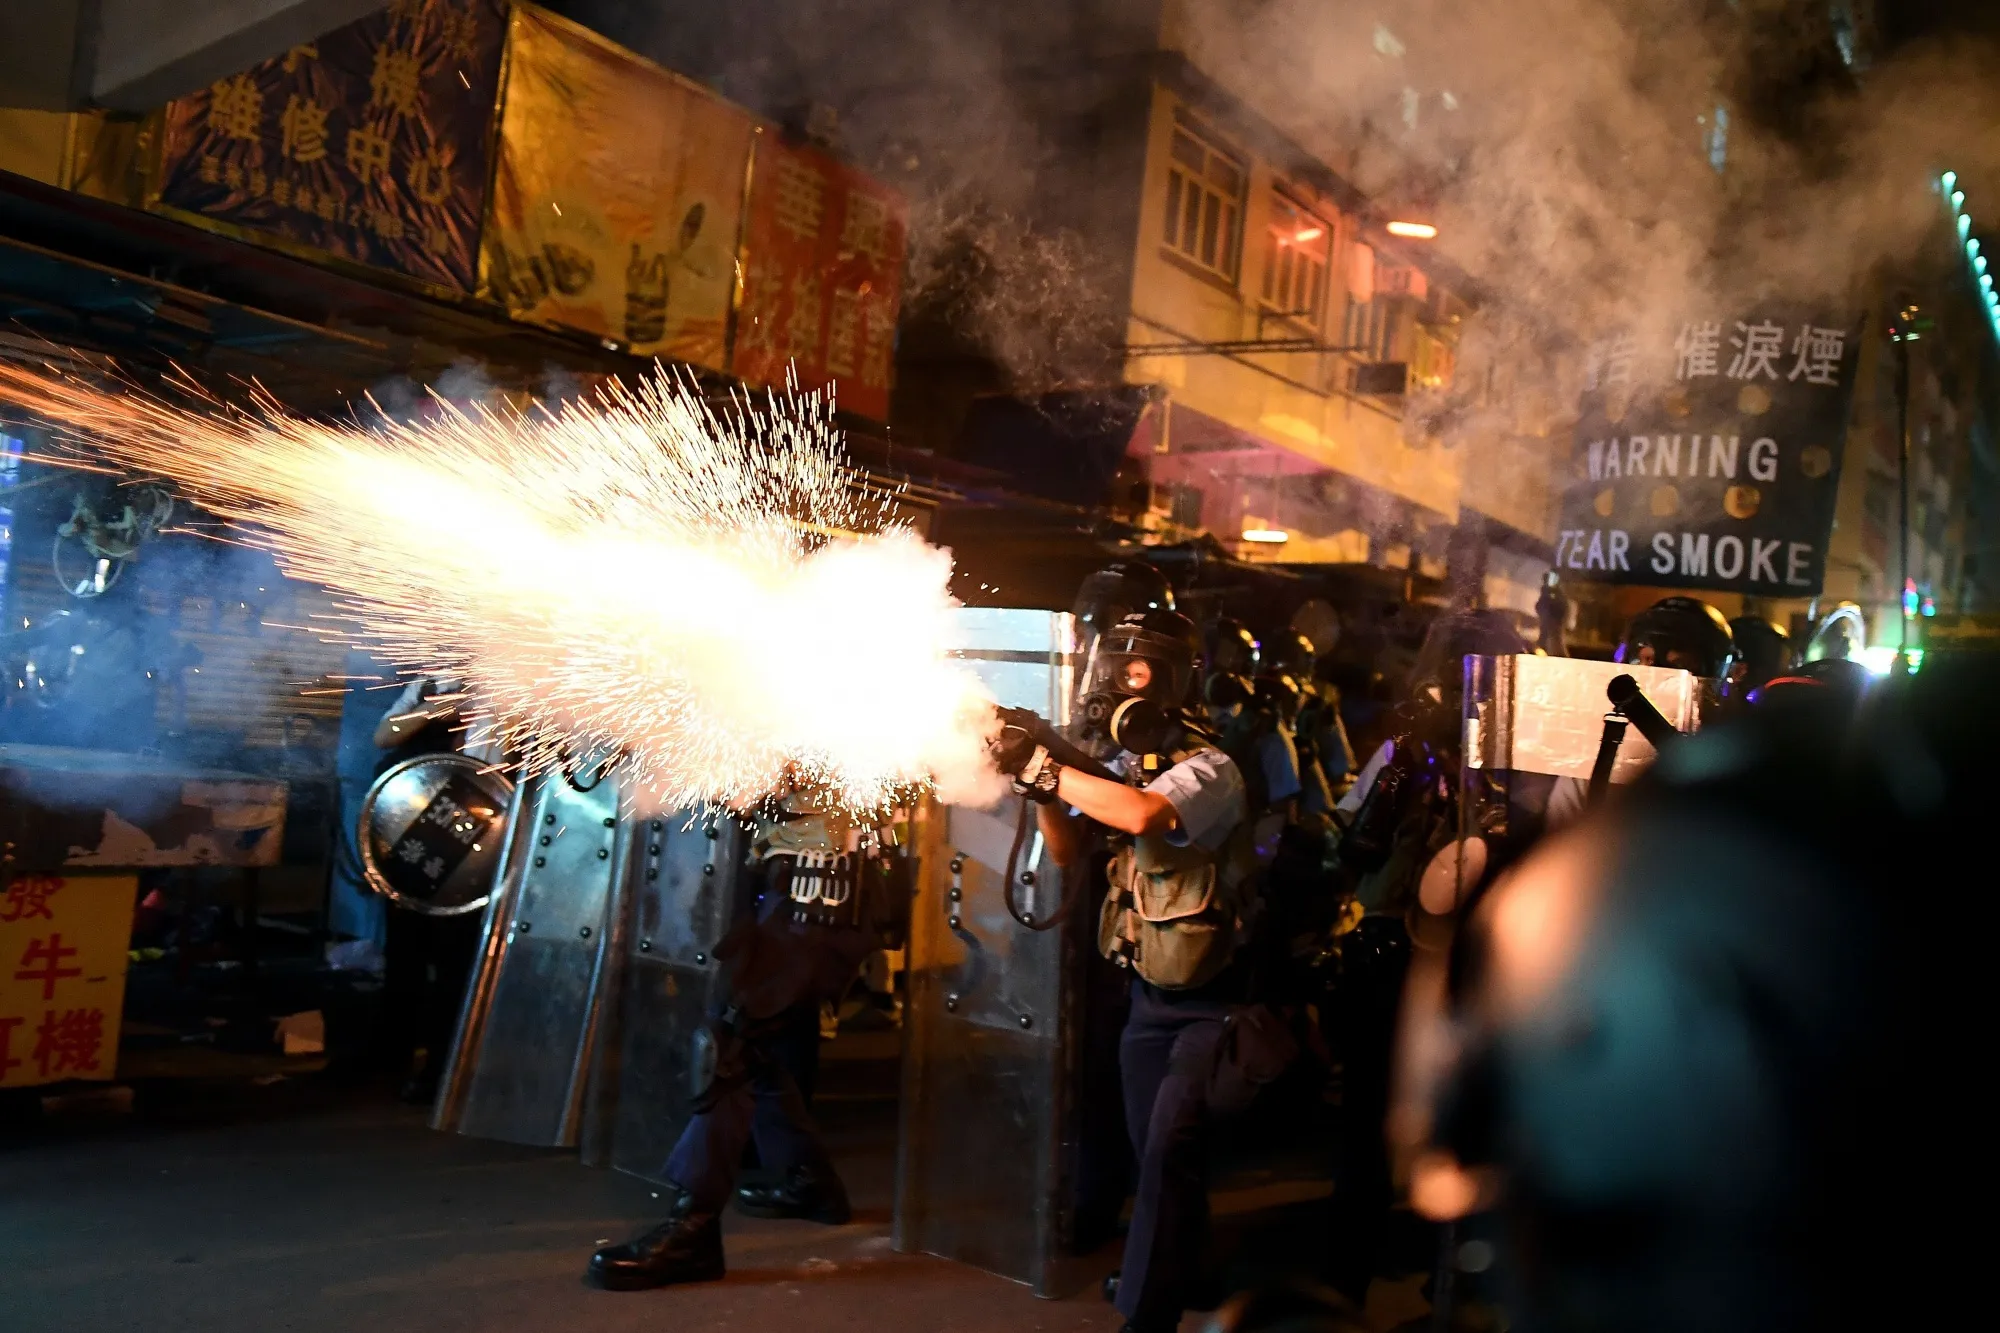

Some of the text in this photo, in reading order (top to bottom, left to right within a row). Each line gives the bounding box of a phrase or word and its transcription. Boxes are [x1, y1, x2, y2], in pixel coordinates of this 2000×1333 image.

[1674, 319, 1847, 387] 催淚煙
[1587, 433, 1779, 483] WARNING
[1555, 529, 1814, 587] TEAR SMOKE
[14, 932, 83, 1001] 牛
